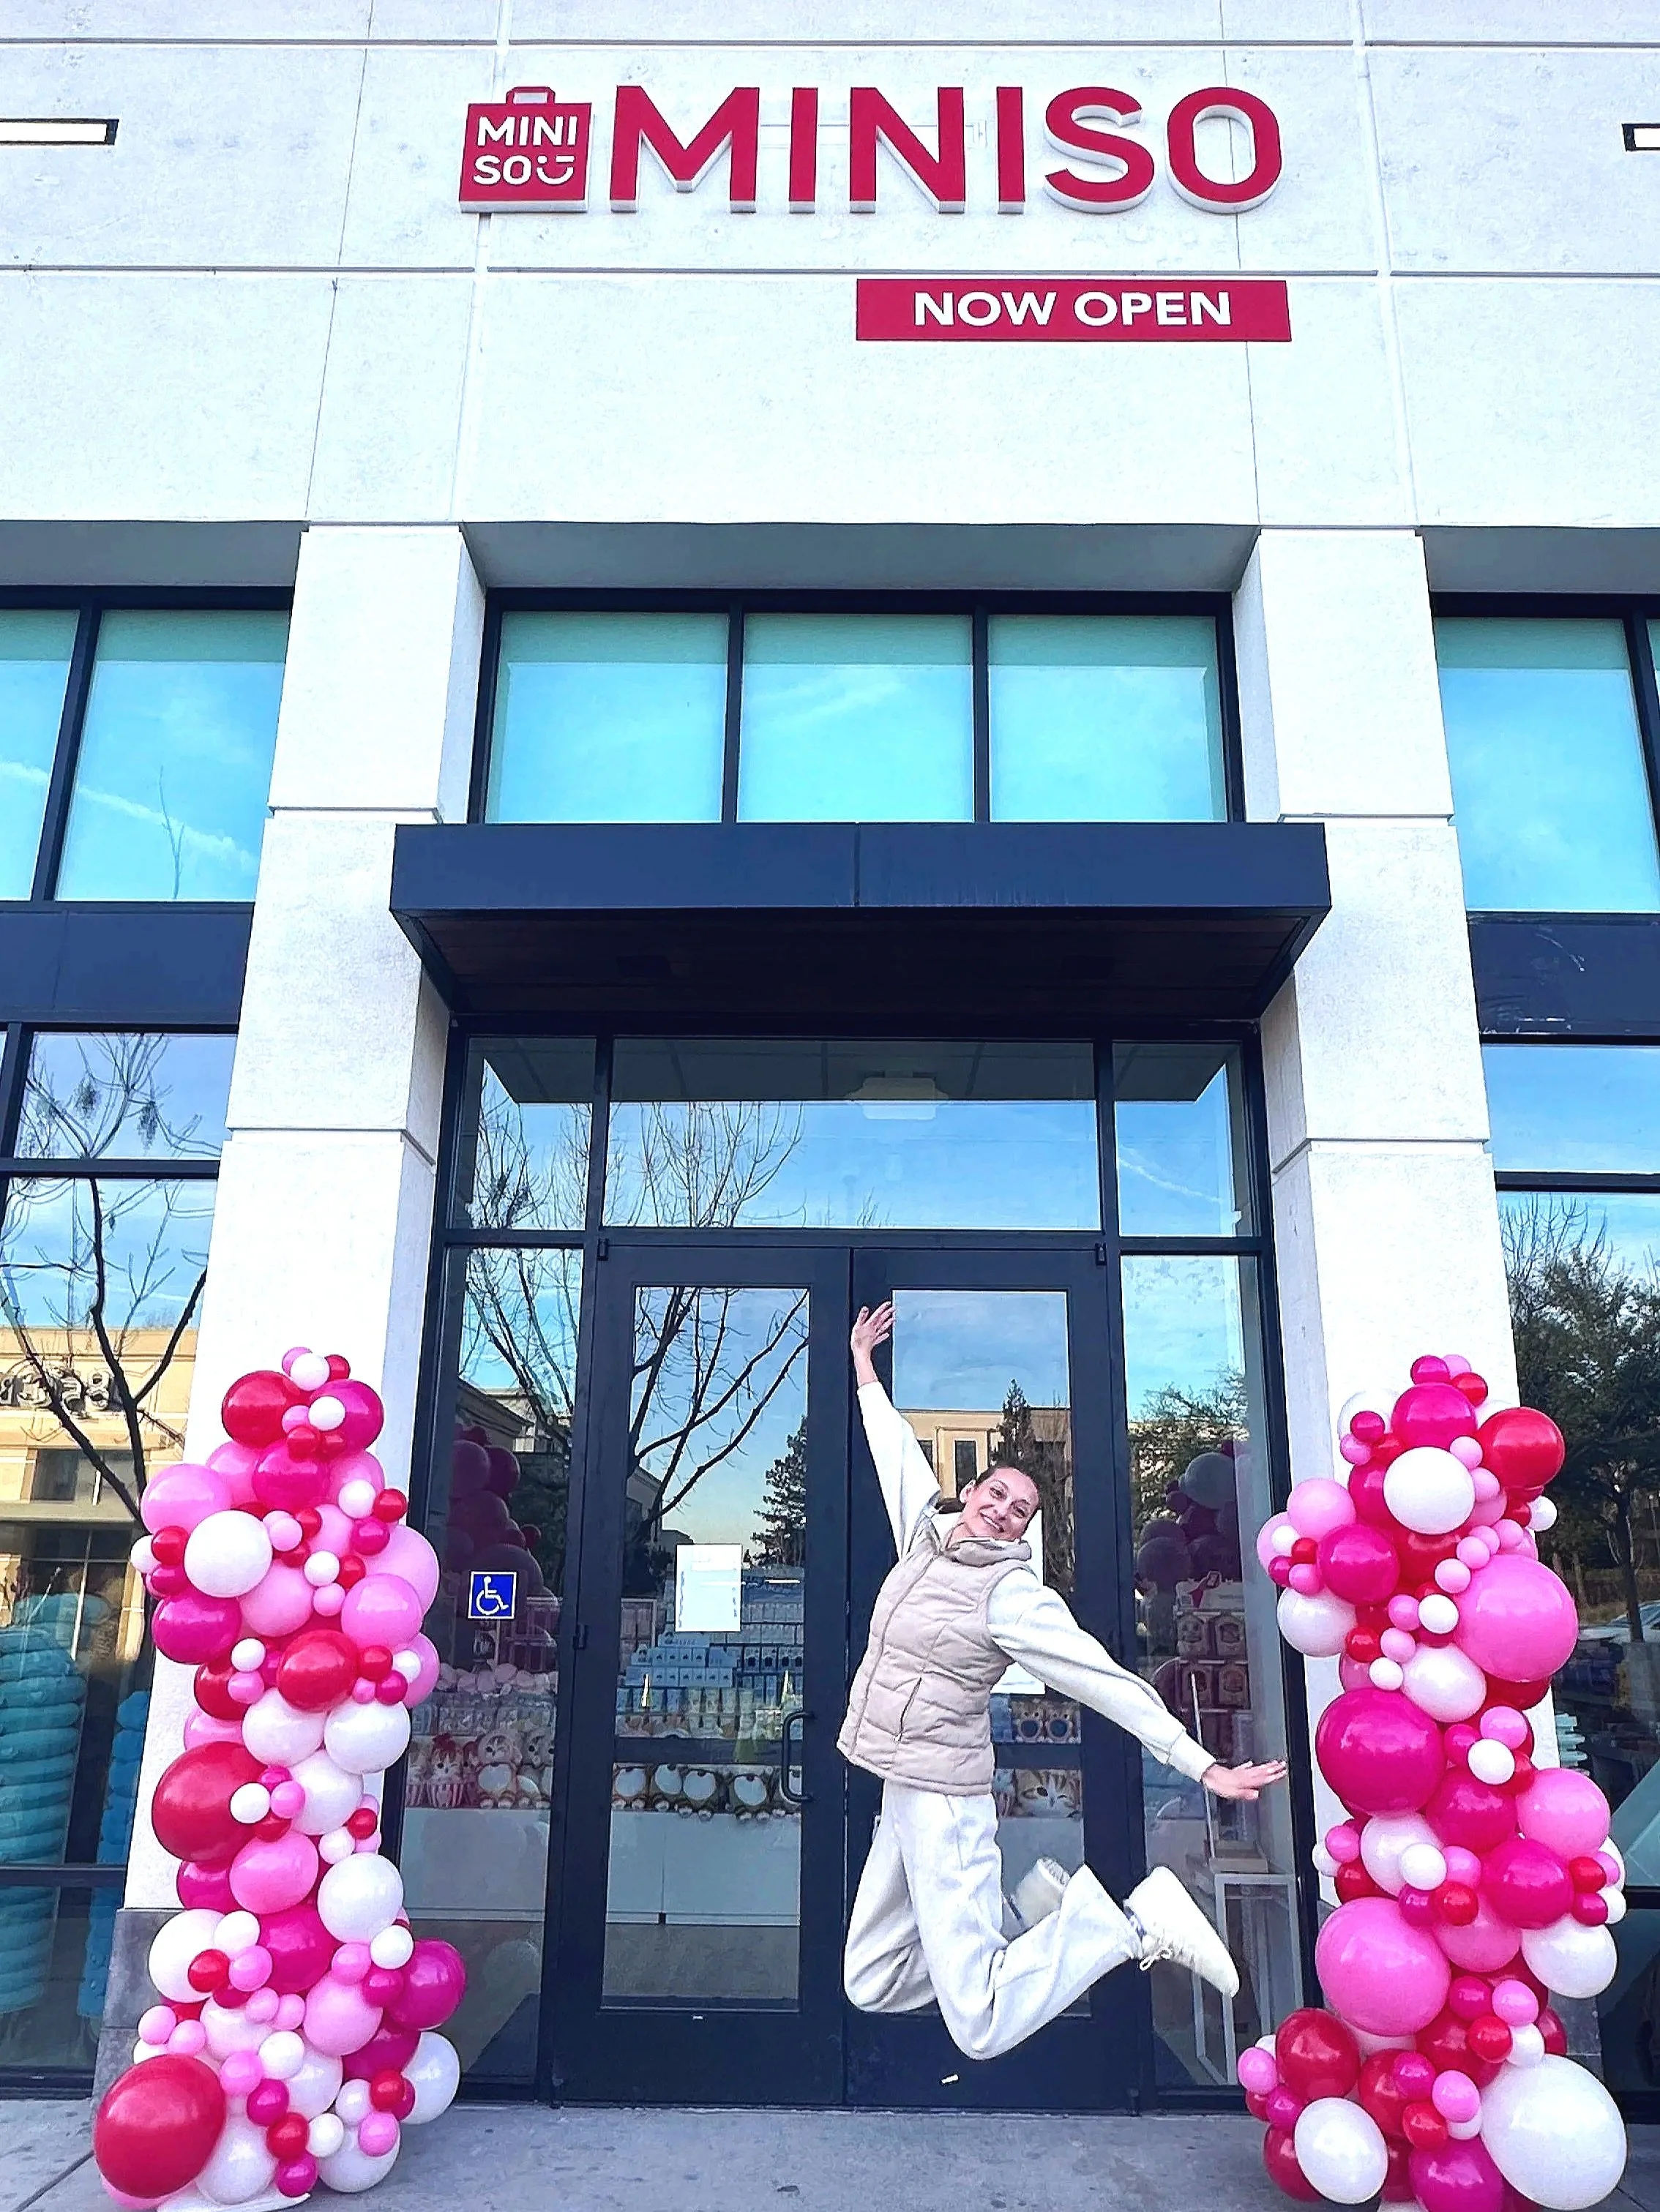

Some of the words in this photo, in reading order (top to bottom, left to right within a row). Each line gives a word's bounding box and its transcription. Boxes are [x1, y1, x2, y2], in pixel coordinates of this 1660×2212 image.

[477, 116, 577, 146] MINI
[609, 84, 1282, 211] MINISO
[914, 292, 1057, 326] NOW
[1074, 292, 1231, 326] OPEN
